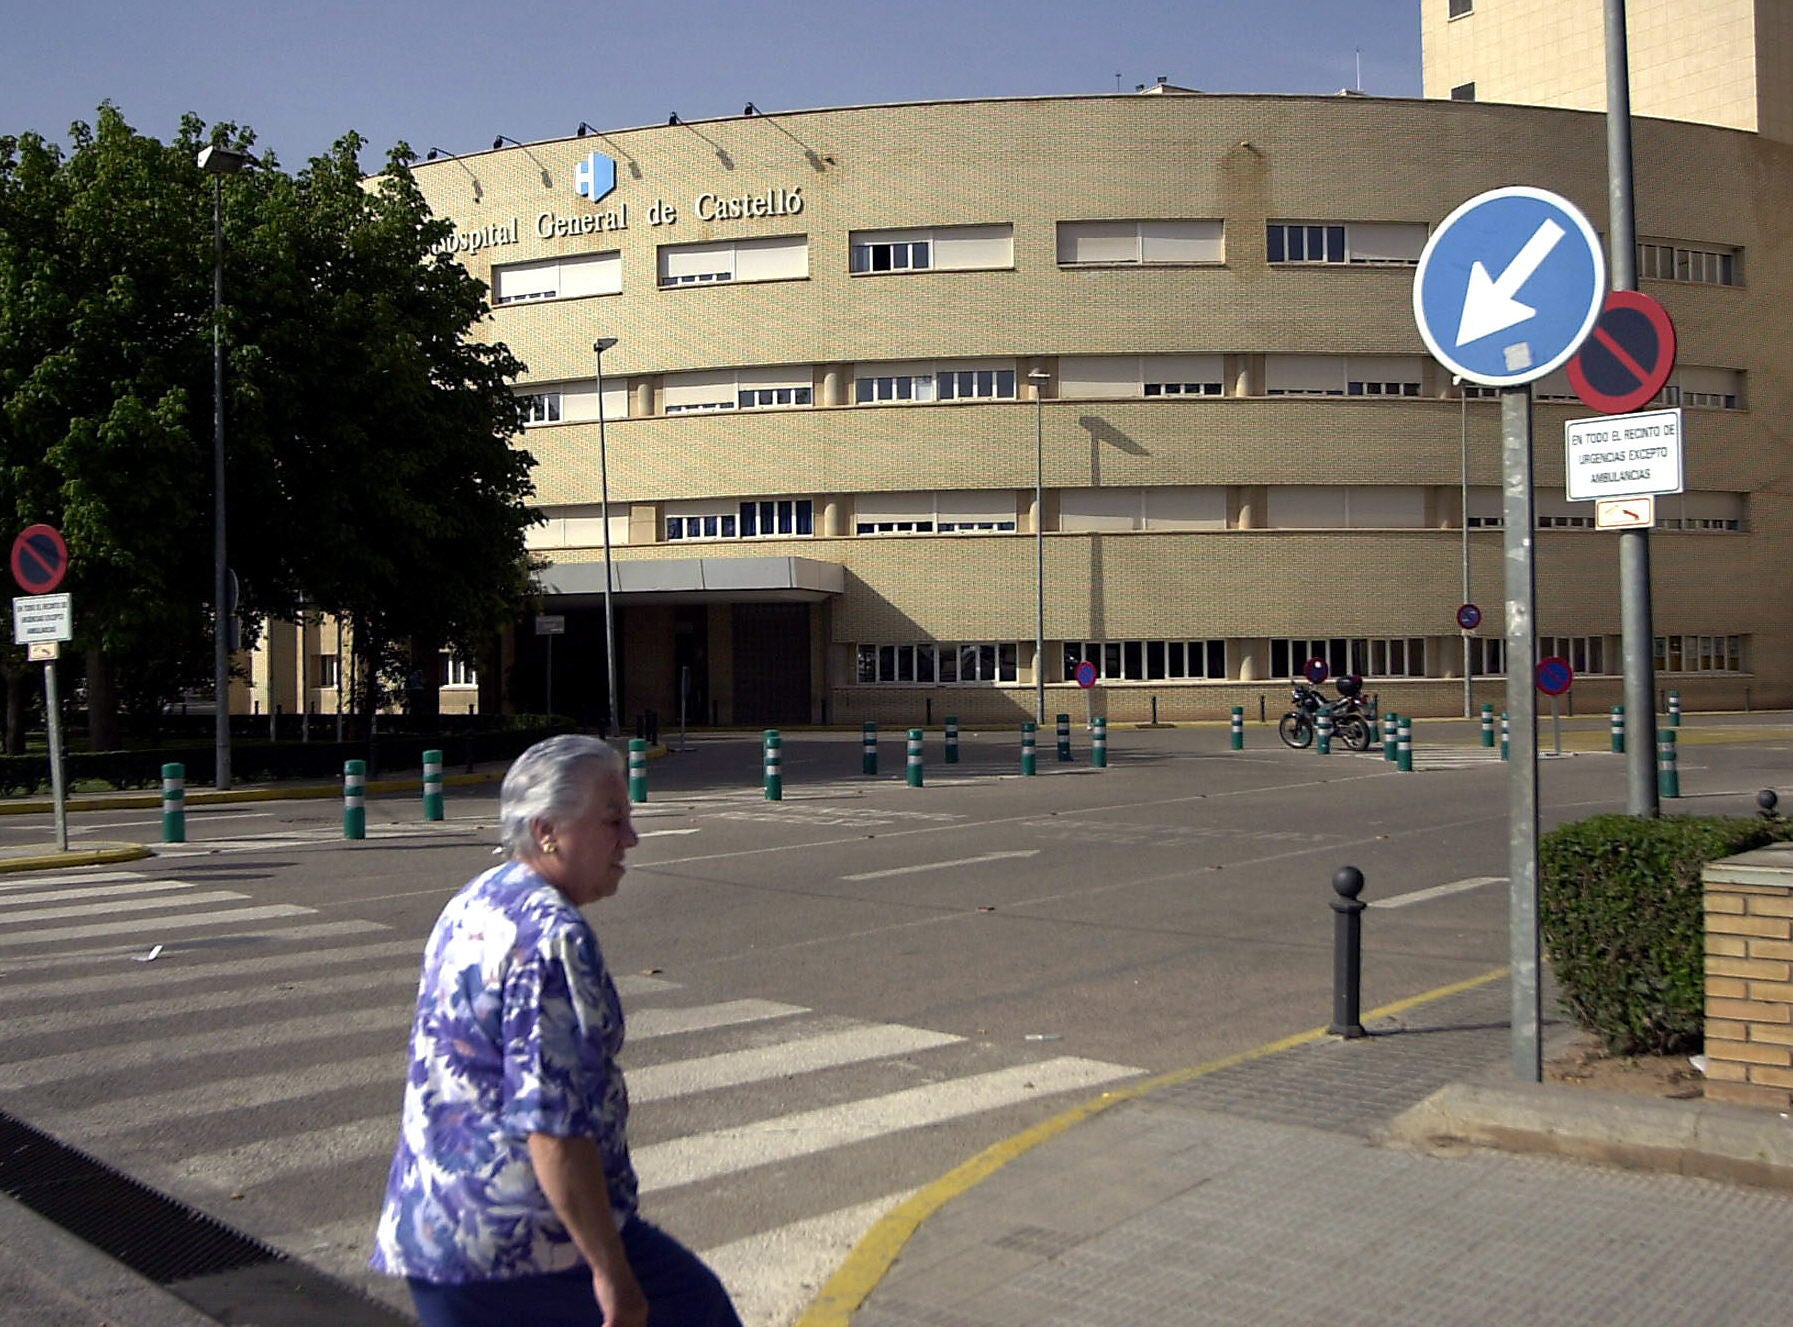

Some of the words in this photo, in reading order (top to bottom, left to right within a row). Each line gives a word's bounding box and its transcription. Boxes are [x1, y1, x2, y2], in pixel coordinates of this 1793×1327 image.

[536, 203, 628, 239] General
[647, 199, 677, 226] de
[694, 185, 804, 221] Castelló
[1572, 435, 1583, 446] EN
[1586, 432, 1608, 444] TODO
[1612, 430, 1622, 442] EL
[1624, 426, 1660, 440] RECINTO
[1663, 424, 1675, 436] DE
[1579, 450, 1626, 465] URGENCIAS
[1629, 446, 1668, 461] EXCEPTO
[1590, 468, 1651, 483] AMBULANCIAS
